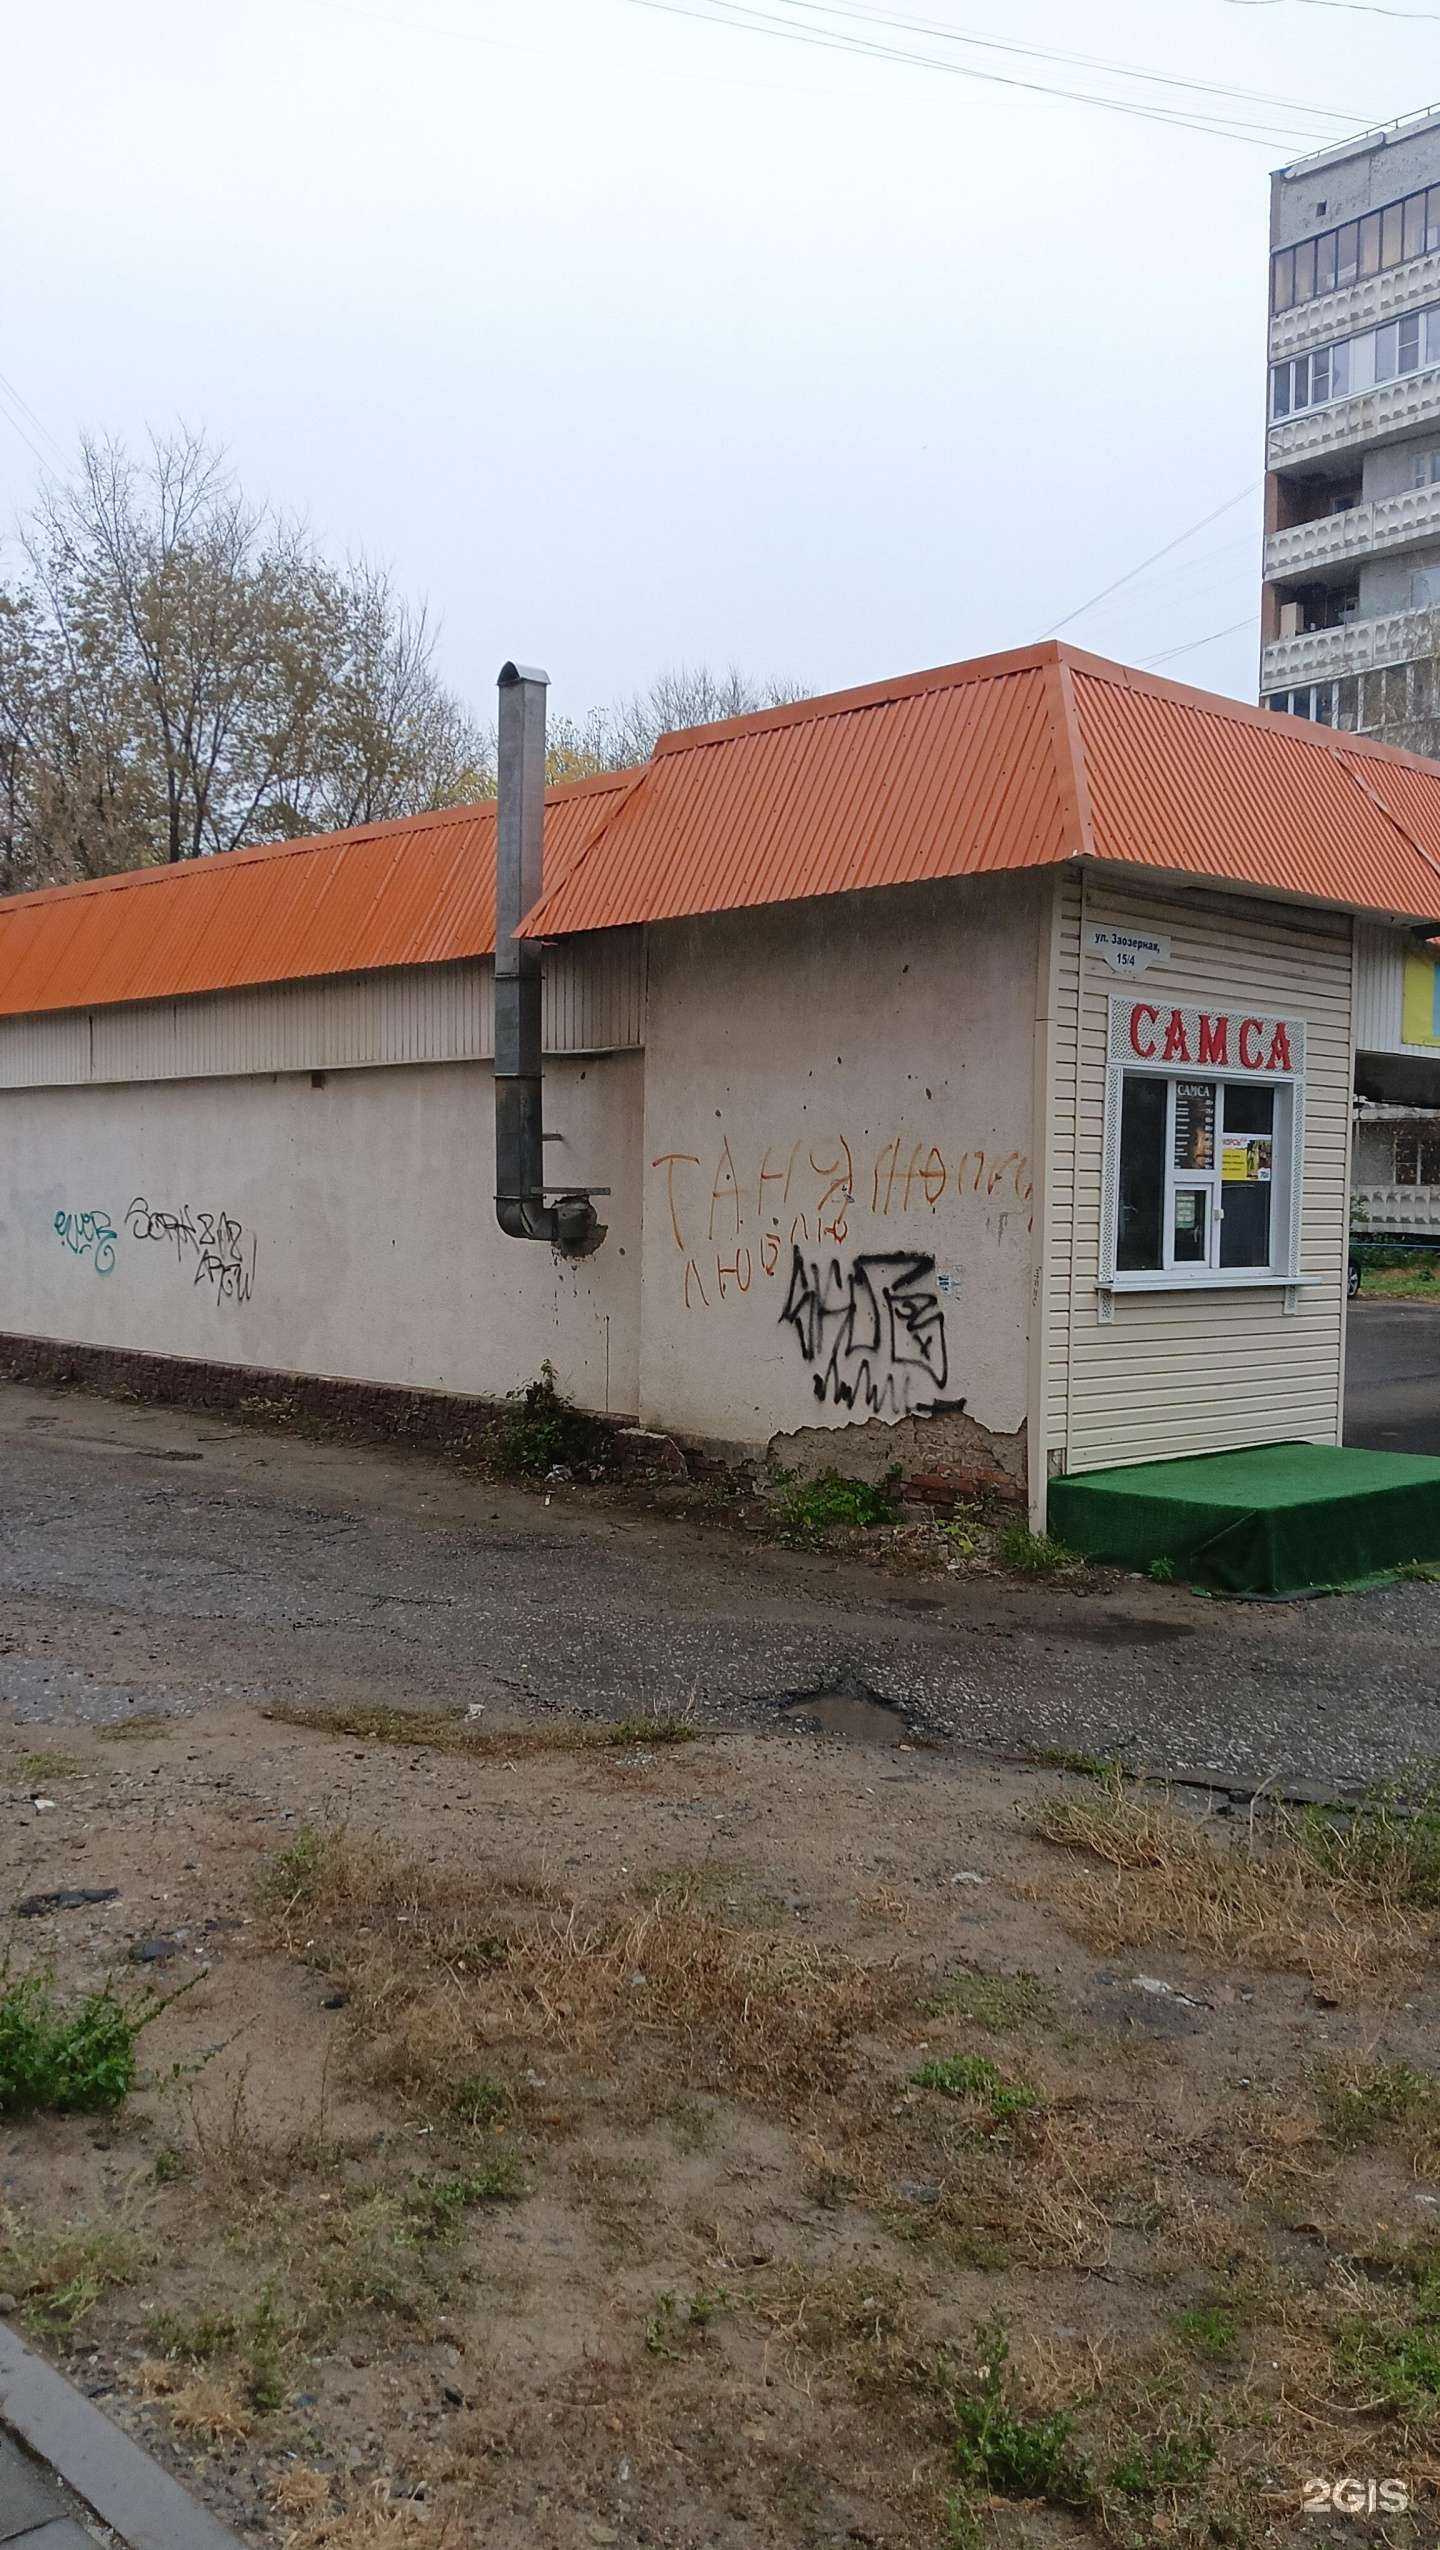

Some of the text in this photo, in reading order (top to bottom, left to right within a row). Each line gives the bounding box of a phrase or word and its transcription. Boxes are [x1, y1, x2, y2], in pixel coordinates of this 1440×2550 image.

[1095, 933, 1160, 954] ул. Заозерная,
[1117, 952, 1135, 966] 15/4
[1130, 1003, 1293, 1071] САМСА
[1177, 1084, 1210, 1097] САМСА
